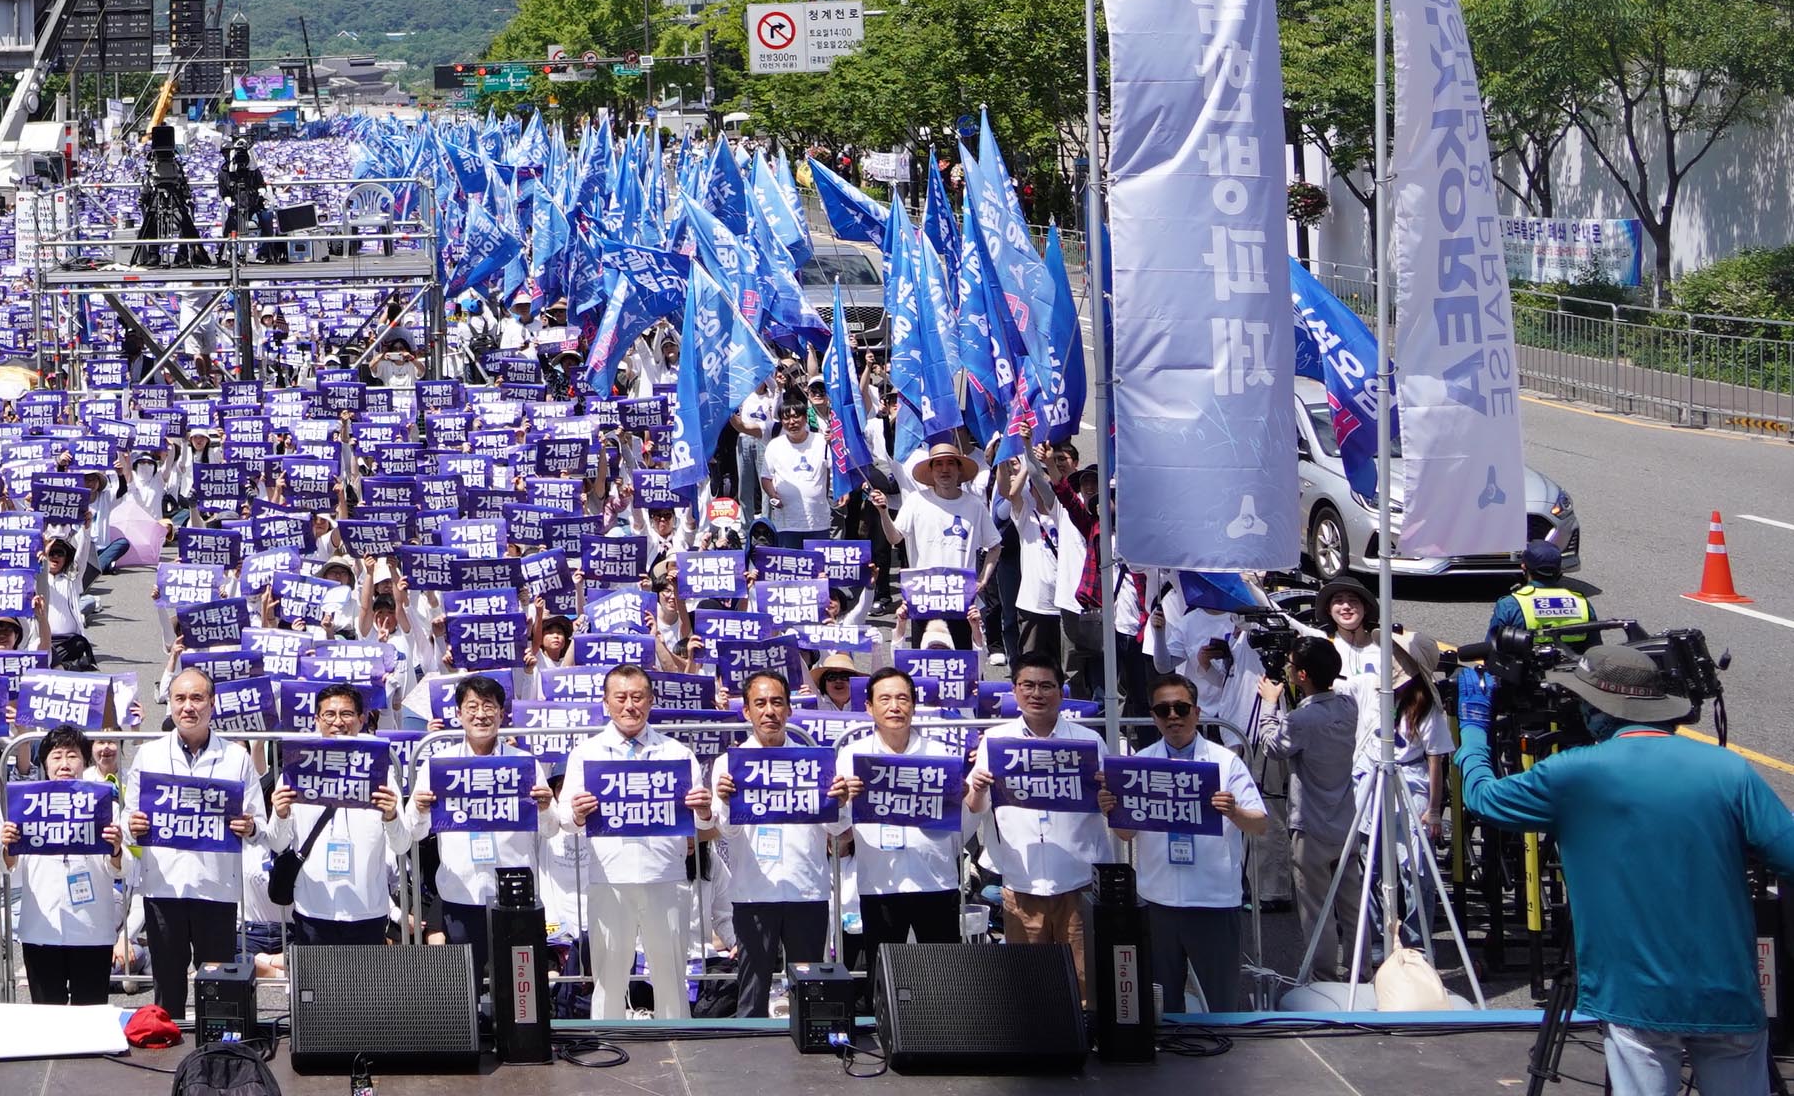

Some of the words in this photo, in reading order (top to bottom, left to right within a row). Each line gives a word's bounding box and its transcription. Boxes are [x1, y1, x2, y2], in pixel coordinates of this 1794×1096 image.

[328, 386, 360, 398] 거룩한
[328, 397, 360, 409] 방파제
[591, 543, 638, 561] 거룩한
[591, 560, 638, 577] 방파제
[687, 561, 736, 576] 거룩한
[687, 574, 736, 593] 방파제
[913, 574, 964, 594] 거룩한
[912, 593, 964, 614] 방파제
[461, 621, 517, 642] 거룩한
[460, 640, 515, 660] 방파제
[299, 749, 373, 778] 거룩한
[744, 759, 821, 787] 거룩한
[1004, 748, 1081, 773] 거룩한
[297, 774, 370, 802] 방파제
[446, 767, 520, 794] 거룩한
[600, 771, 677, 799] 거룩한
[870, 765, 947, 794] 거룩한
[1005, 773, 1083, 801] 방파제
[1122, 769, 1202, 798] 거룩한
[23, 792, 97, 818] 거룩한
[154, 784, 227, 811] 거룩한
[446, 796, 519, 824] 방파제
[743, 789, 819, 817] 방파제
[868, 790, 944, 820] 방파제
[1124, 796, 1202, 825] 방파제
[152, 812, 226, 840] 방파제
[600, 800, 676, 829] 방파제
[22, 821, 95, 847] 방파제
[517, 951, 529, 978] Fire
[1119, 950, 1132, 977] Fire
[517, 981, 531, 1020] Storm
[1119, 979, 1132, 1019] Storm
